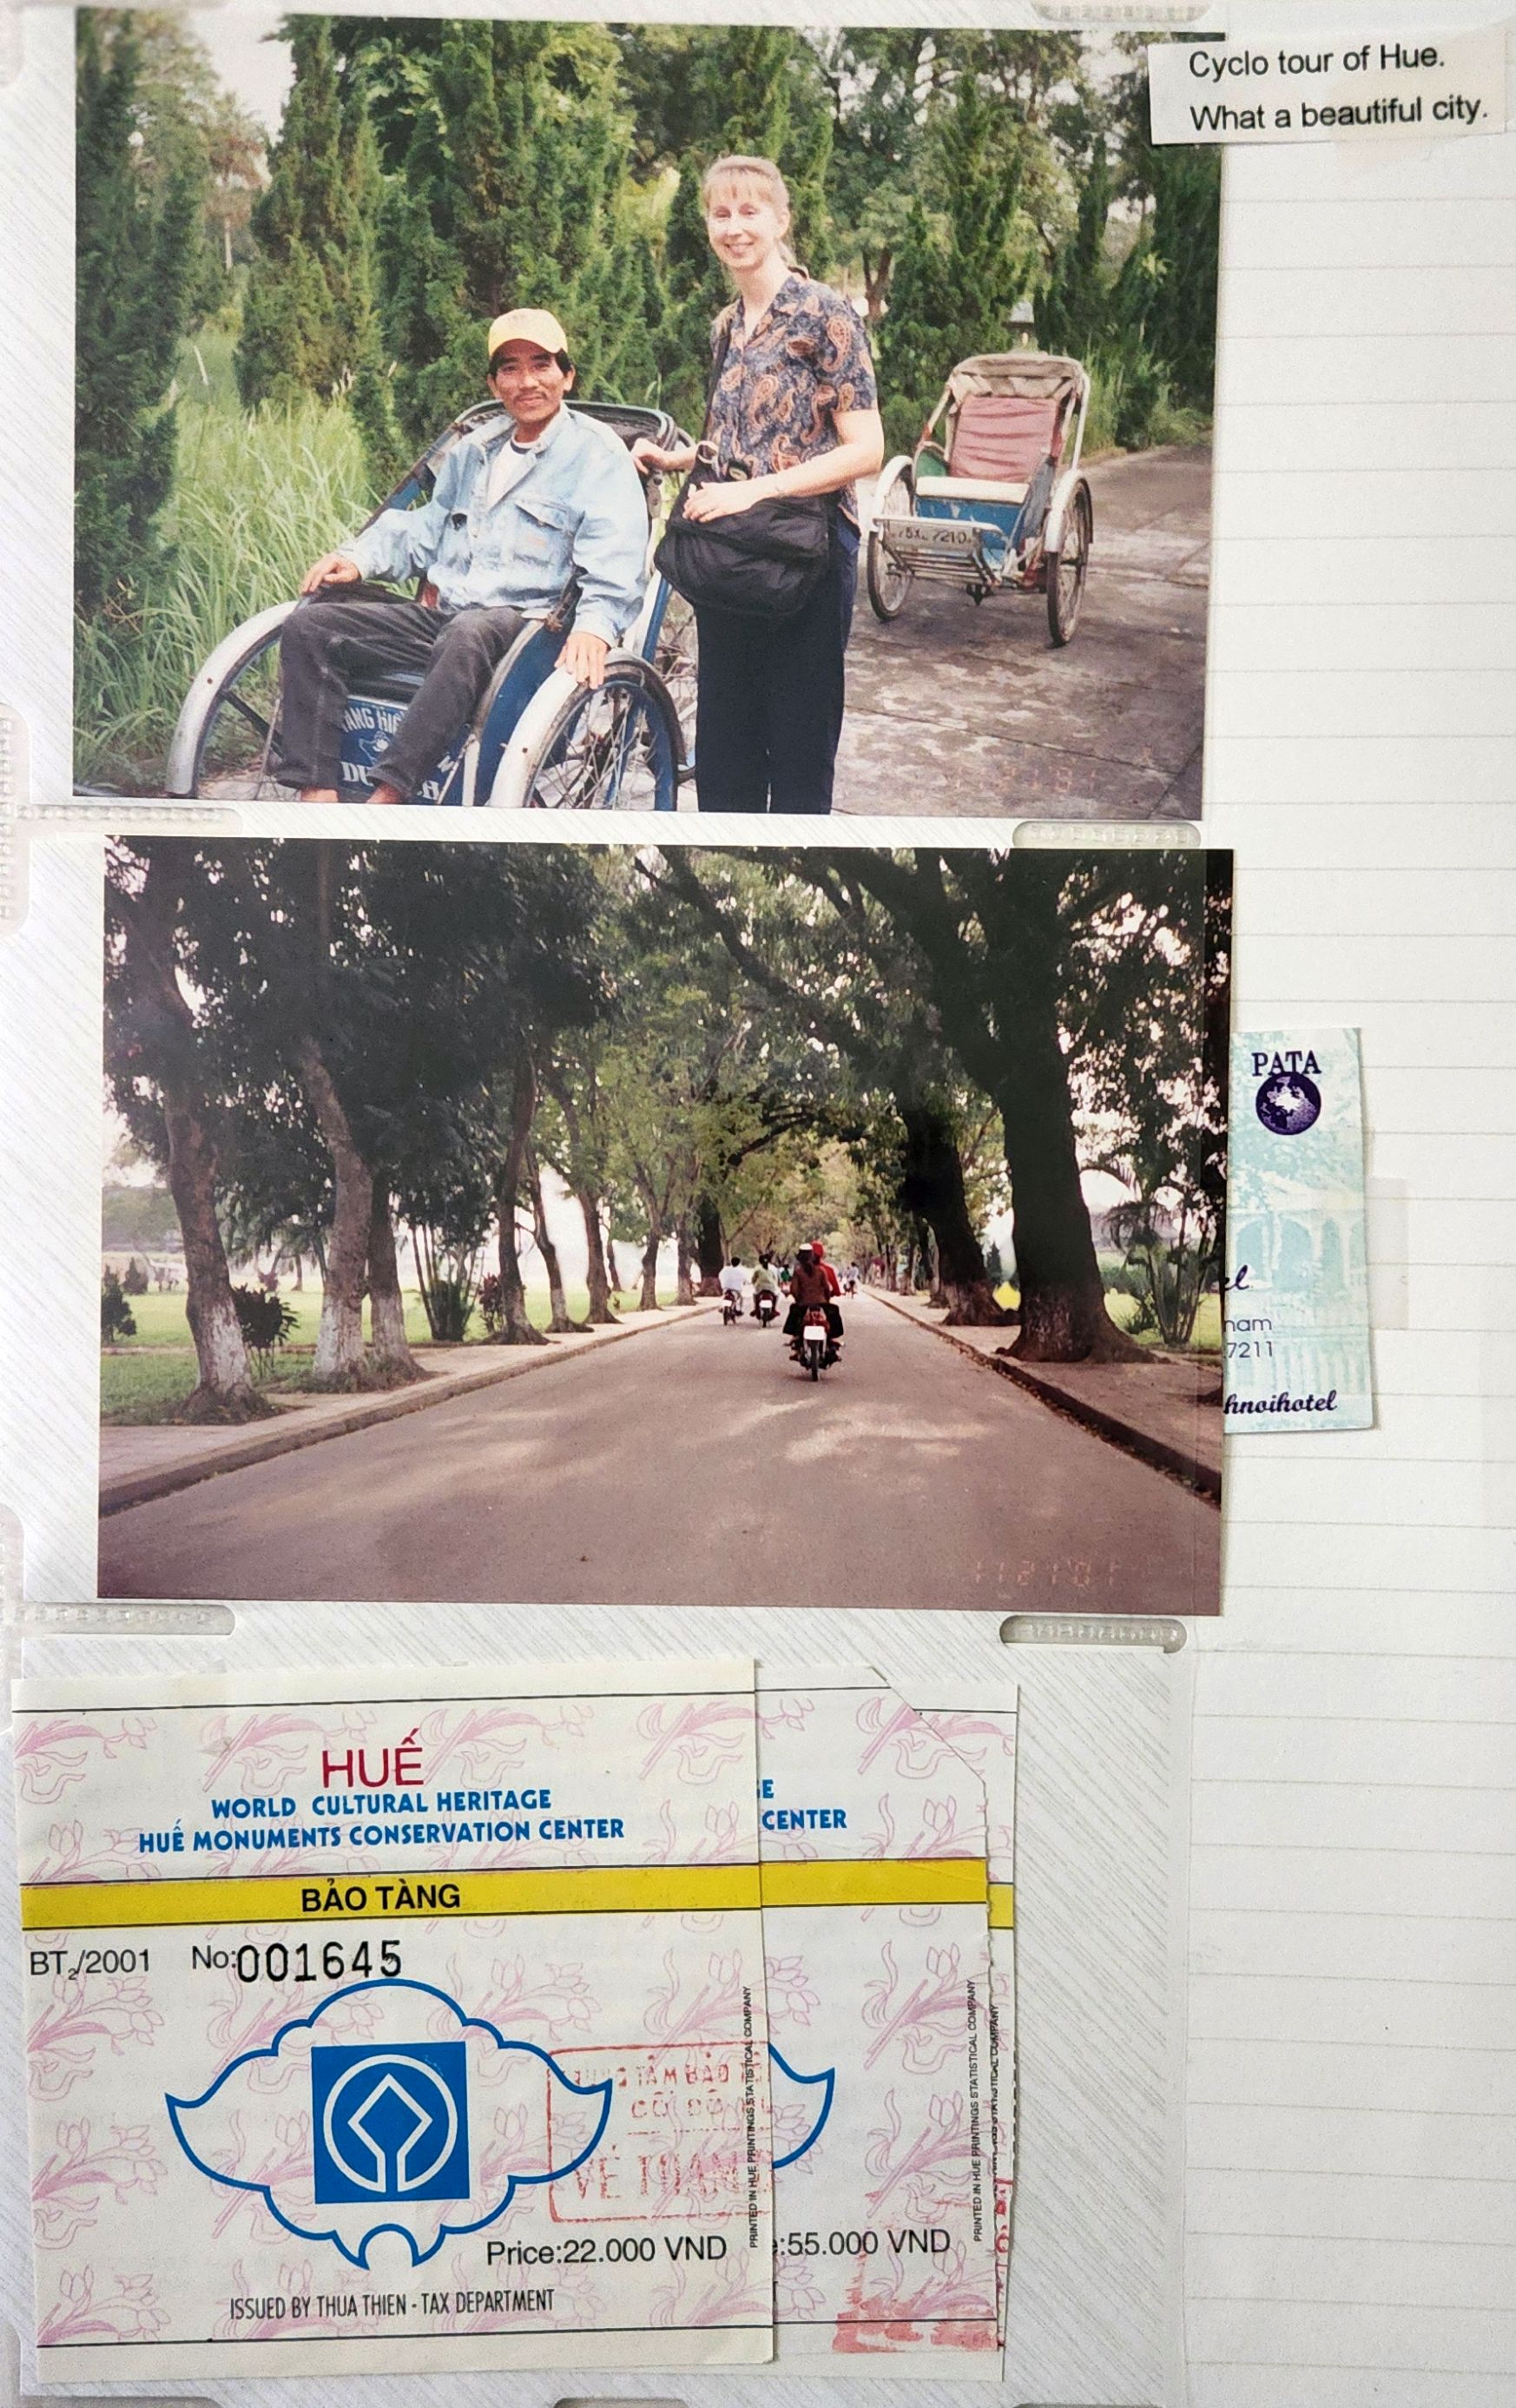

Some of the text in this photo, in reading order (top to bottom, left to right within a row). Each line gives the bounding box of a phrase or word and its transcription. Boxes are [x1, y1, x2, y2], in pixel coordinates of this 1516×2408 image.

[1189, 43, 1445, 82] Cyclo tour of Hue.
[1190, 94, 1488, 131] What a beautiful city.
[1252, 1052, 1321, 1077] PATA
[1227, 1342, 1273, 1358] 7211
[1223, 1389, 1337, 1415] hnoihotel
[322, 1728, 425, 1788] HUẾ
[212, 1789, 552, 1818] WORLD CULTURAL HERITAGE
[139, 1818, 625, 1853] HUẾ MONUMENTS CONSERVATION CENTER
[761, 1809, 847, 1831] CENTER
[301, 1878, 461, 1912] BẢO TÀNG
[742, 1986, 759, 2248] PRINTED IN HUE PRINTINGS STATISTICAL COMPANY
[966, 1979, 983, 2242] PRINTED IN HUE PRINTINGS STATISTICAL COMPANY
[486, 2235, 727, 2266] Price:22.000 VND
[887, 2228, 951, 2253] VND
[230, 2297, 286, 2319] ISSUED
[292, 2297, 311, 2318] BY
[318, 2295, 358, 2317] THUA
[362, 2294, 406, 2316] THIEN
[421, 2293, 449, 2314] TAX
[455, 2288, 555, 2312] DEPARTMENT
